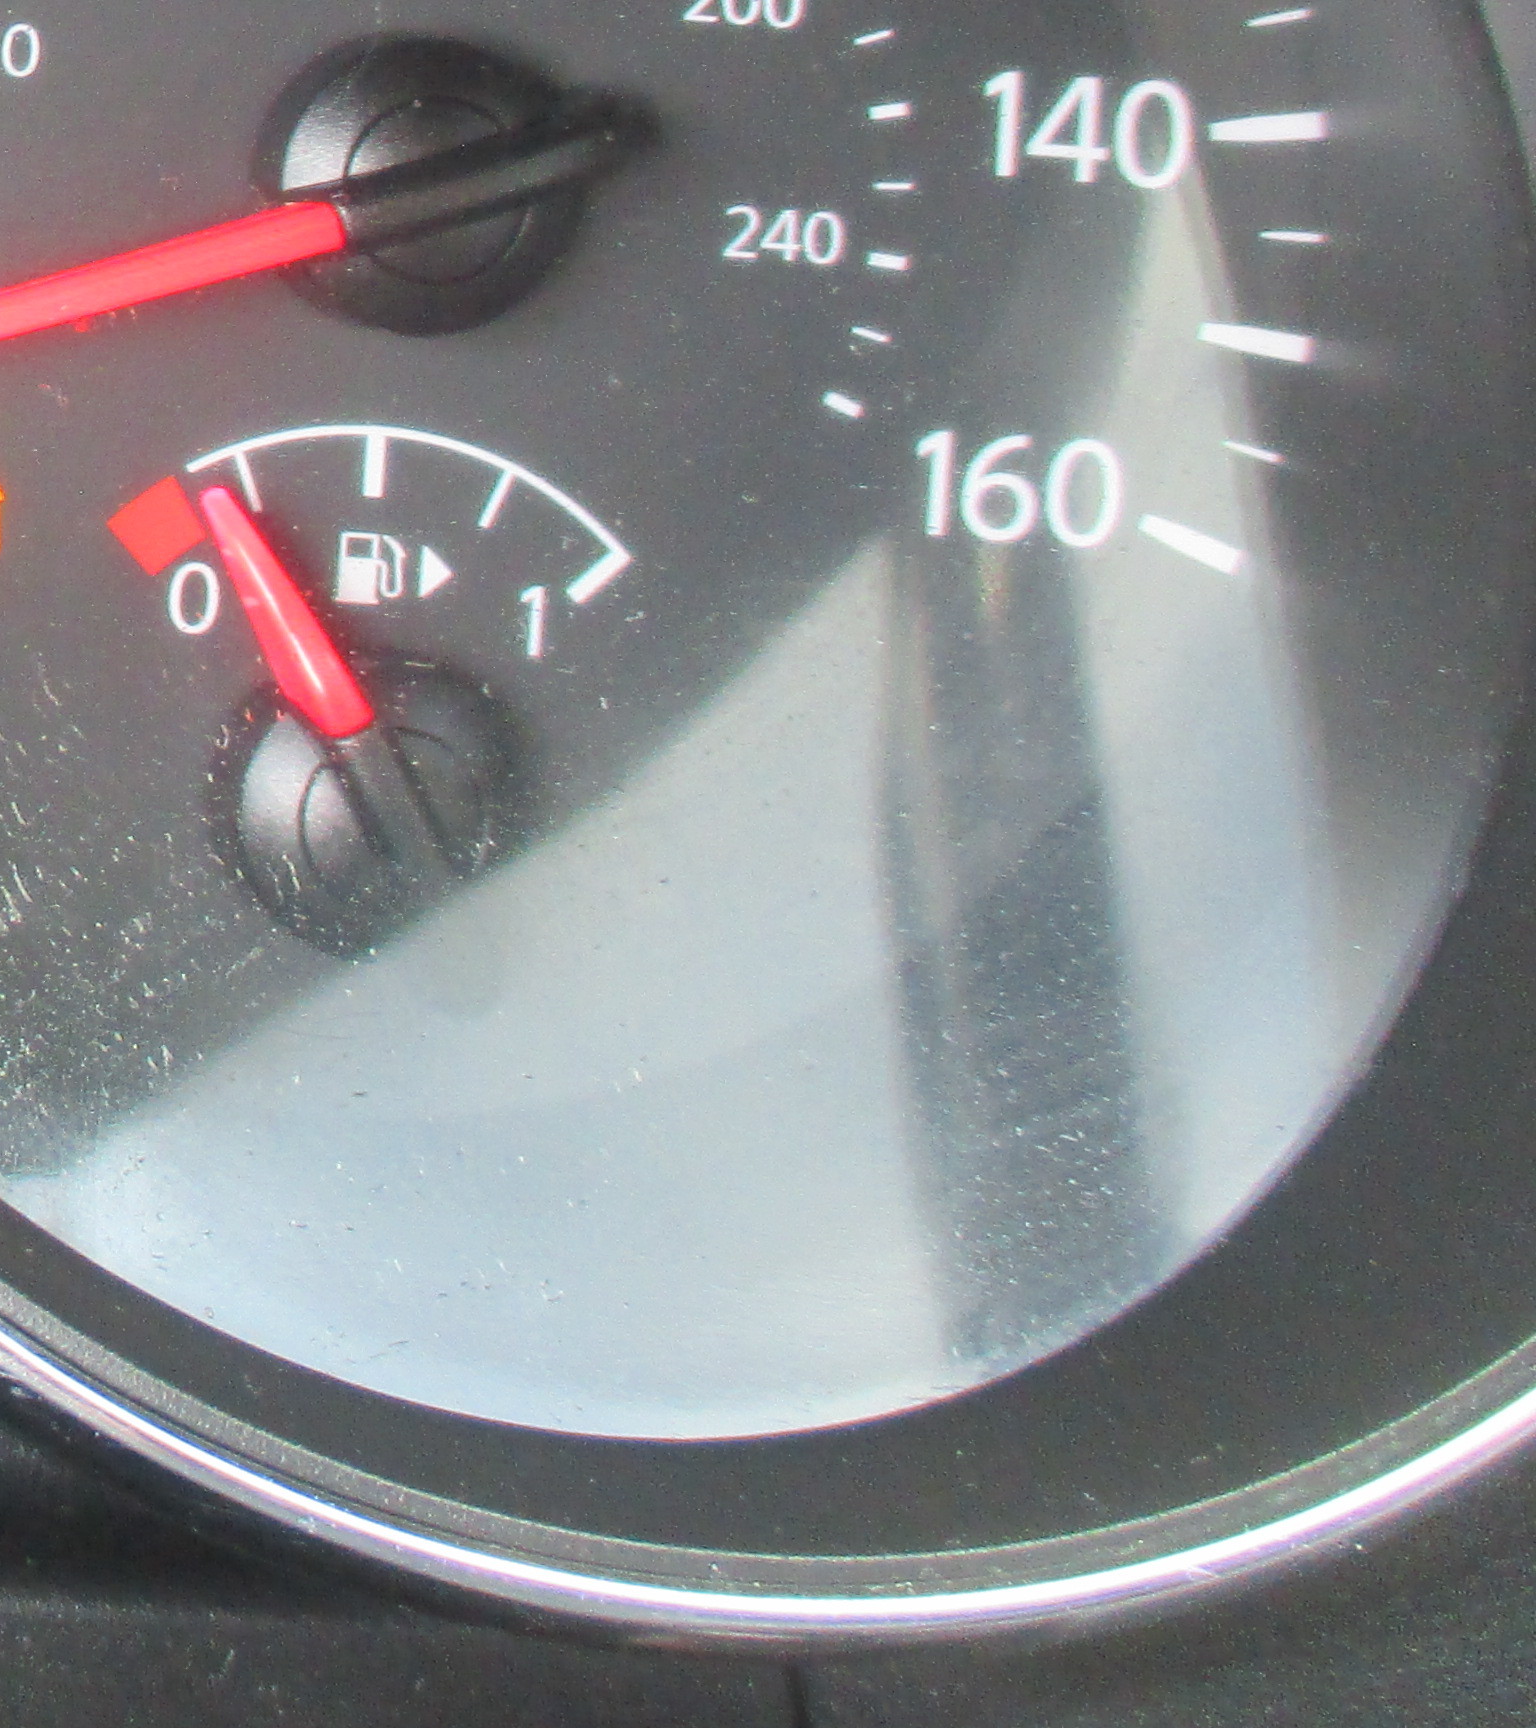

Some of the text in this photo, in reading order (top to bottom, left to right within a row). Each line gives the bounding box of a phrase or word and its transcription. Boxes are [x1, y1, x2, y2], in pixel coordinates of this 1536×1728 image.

[987, 71, 1194, 191] 140
[724, 206, 843, 266] 240
[919, 429, 1127, 548] 160
[169, 562, 219, 634] 0
[522, 587, 545, 657] 1
